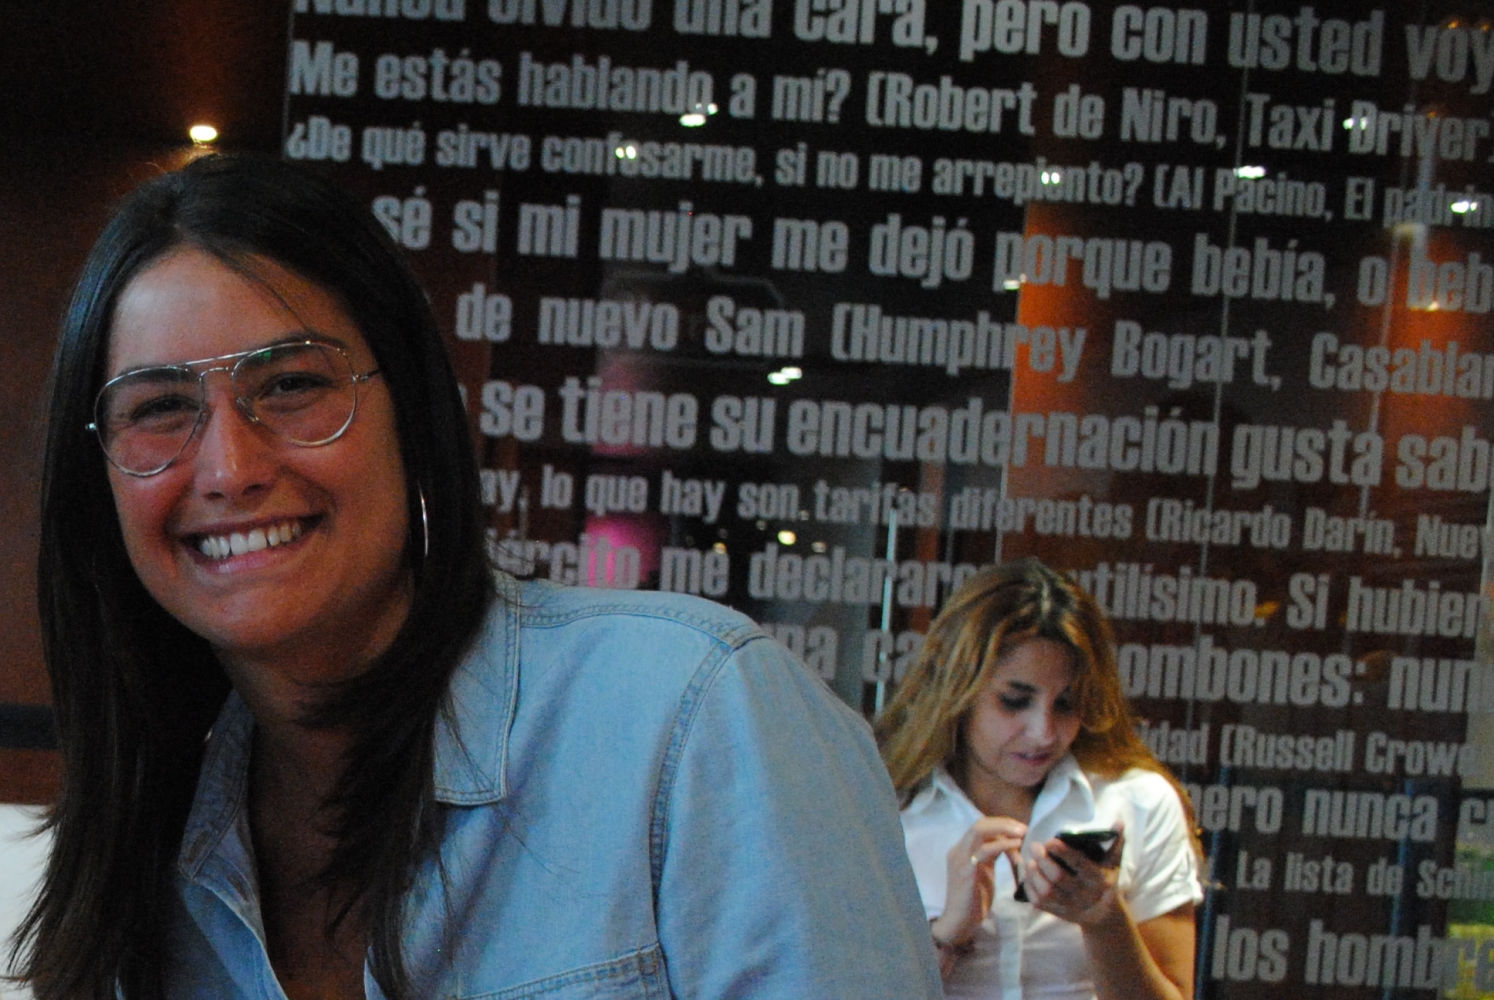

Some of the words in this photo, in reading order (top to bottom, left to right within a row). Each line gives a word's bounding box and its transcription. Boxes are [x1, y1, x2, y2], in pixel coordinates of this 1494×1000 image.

[793, 0, 938, 55] cara,
[959, 0, 1092, 61] pero
[1111, 5, 1208, 66] con
[1227, 6, 1385, 77] usted
[1405, 24, 1494, 94] voy
[289, 40, 358, 96] Me
[375, 48, 502, 103] estás
[518, 52, 714, 118] hablando
[729, 72, 756, 120] a
[866, 71, 1036, 136] (Robert
[1052, 85, 1104, 140] de
[1120, 87, 1226, 149] Niro,
[1246, 92, 1335, 151] Taxi
[1349, 99, 1494, 163] Driver
[287, 117, 352, 163] ¿De
[362, 120, 425, 170] qué
[436, 123, 531, 171] sirve
[541, 132, 764, 188] confesarme,
[775, 141, 807, 186] si
[816, 150, 859, 190] no
[868, 152, 923, 193] me
[932, 157, 1143, 207] arrepiento?
[1153, 162, 1204, 211] (Al
[1213, 167, 1333, 222] Pacino,
[1344, 176, 1374, 221] El
[1382, 182, 1494, 229] padrin
[451, 190, 500, 254] si
[517, 195, 581, 258] mi
[599, 202, 752, 275] mujer
[772, 215, 849, 275] me
[869, 213, 974, 289] dejó
[993, 230, 1173, 299] porque
[1191, 232, 1336, 311] bebía,
[1358, 256, 1388, 306] o
[455, 283, 512, 342] de
[537, 296, 679, 351] nuevo
[705, 297, 806, 360] Sam
[831, 302, 1087, 383] (Humphrey
[1111, 320, 1281, 391] Bogart,
[479, 380, 545, 443] se
[560, 376, 699, 449] tiene
[710, 395, 777, 455] su
[787, 397, 1219, 475] encuadernación
[1231, 420, 1384, 490] gusta
[1395, 425, 1494, 492] sab
[540, 464, 573, 509] lo
[585, 472, 648, 517] que
[661, 470, 725, 521] hay
[813, 480, 937, 526] tarifas
[950, 486, 1134, 538] diferentes
[1145, 499, 1292, 549] (Ricardo
[659, 545, 730, 598] me
[748, 542, 978, 608] declarar
[1286, 572, 1331, 630] Si
[1345, 576, 1494, 638] hubier
[1118, 634, 1367, 708] ombones:
[1219, 723, 1356, 772] (Russell
[1302, 788, 1439, 842] nunca
[1236, 850, 1272, 890] La
[1284, 852, 1354, 894] lista
[1366, 857, 1404, 896] de
[1211, 914, 1290, 982] los
